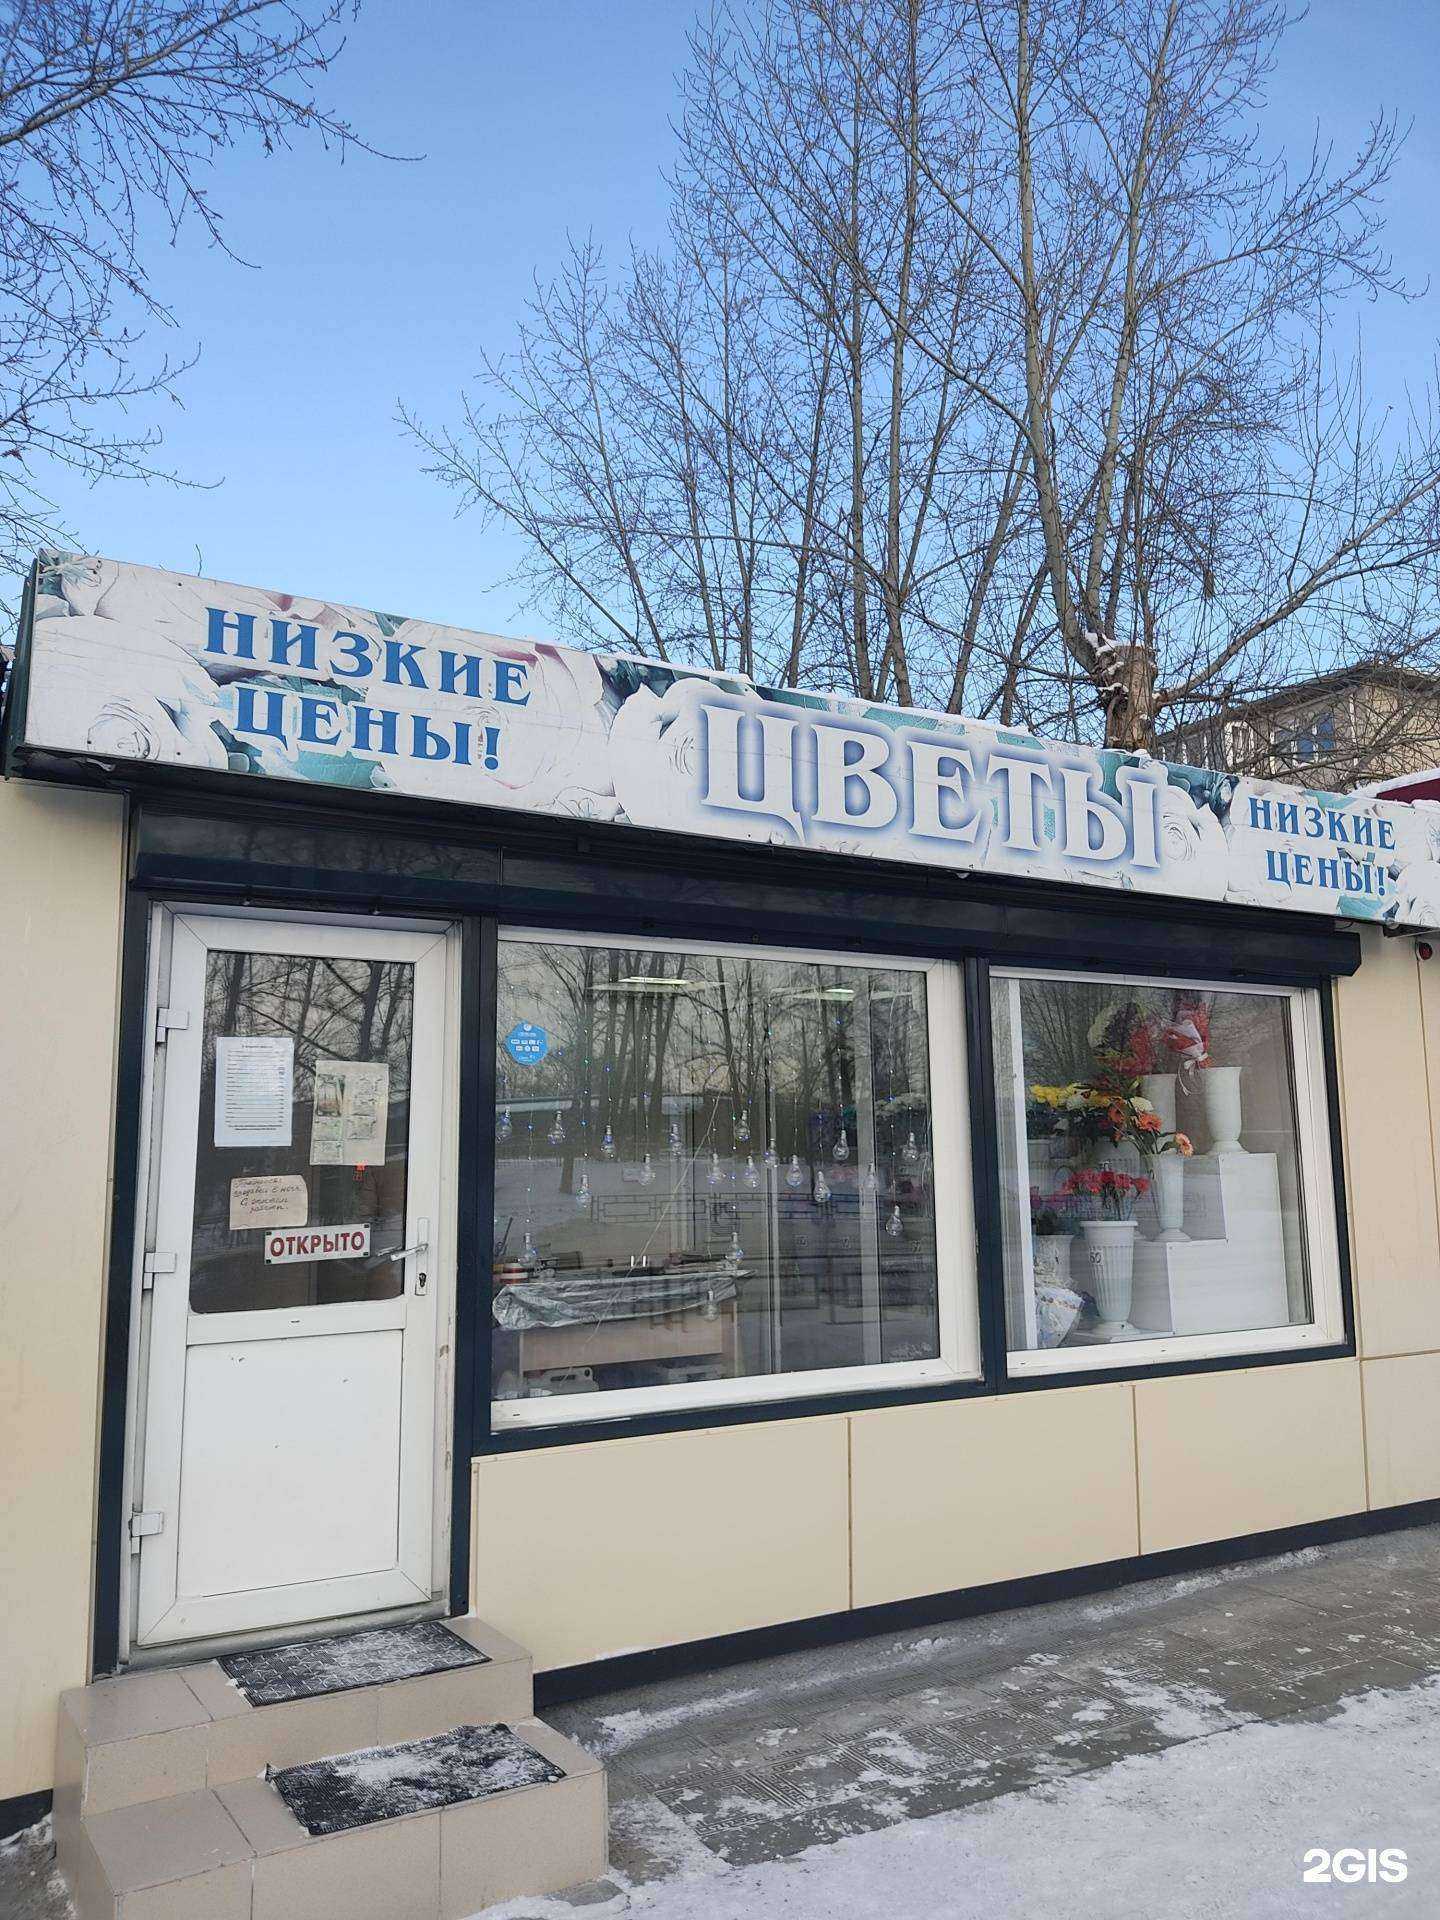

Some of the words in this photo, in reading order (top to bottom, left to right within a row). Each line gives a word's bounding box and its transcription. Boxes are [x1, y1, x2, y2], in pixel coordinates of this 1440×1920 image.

[203, 606, 532, 707] НИЗКИЕ
[233, 685, 501, 771] ЦЕНЫ!
[700, 702, 1161, 869] ЦВЕТЫ
[1247, 796, 1397, 850] НИЗКИЕ
[1265, 849, 1386, 897] ЦЕНЫ!
[270, 1231, 366, 1257] ОТКРЫТО
